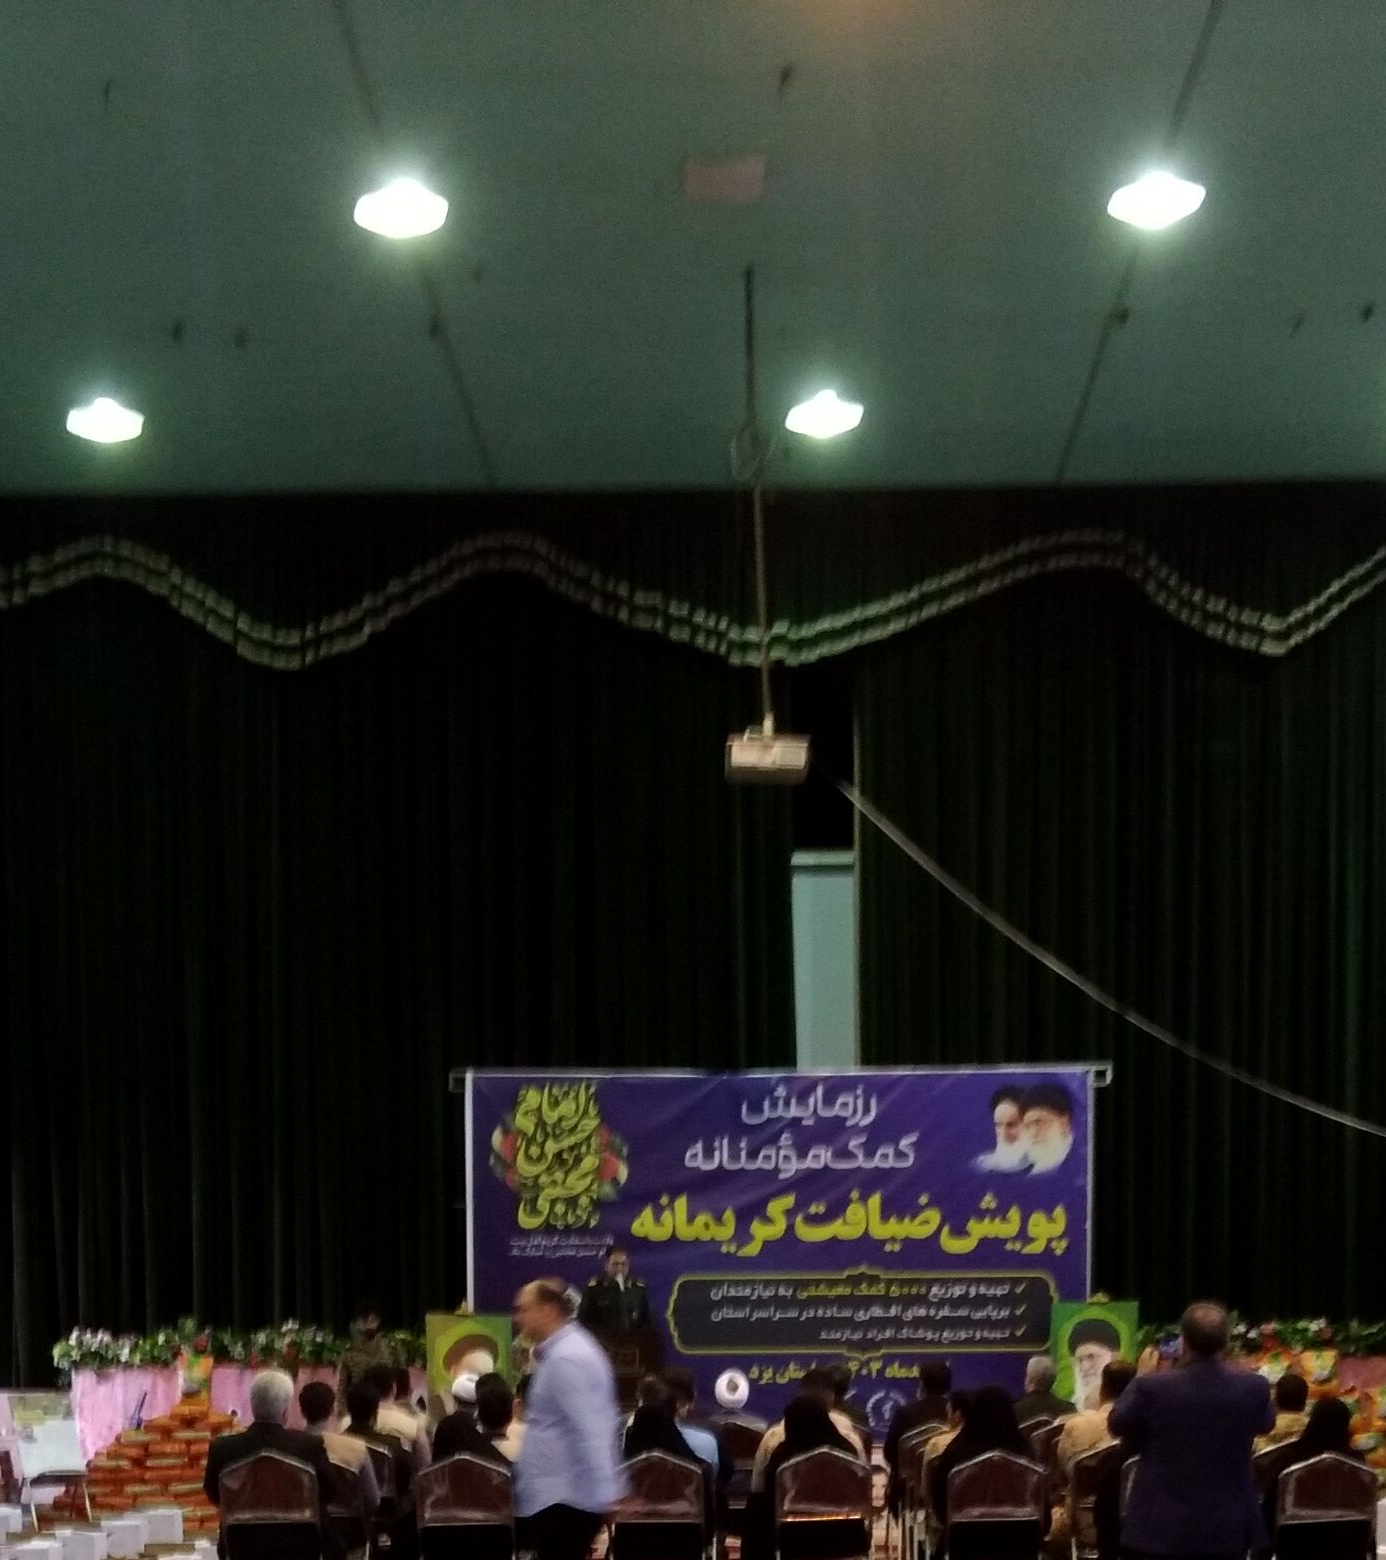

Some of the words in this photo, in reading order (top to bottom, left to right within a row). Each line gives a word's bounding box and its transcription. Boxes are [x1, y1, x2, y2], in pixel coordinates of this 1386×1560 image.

[741, 1083, 878, 1127] رزمایش
[684, 1131, 827, 1180] مؤمنانه
[826, 1131, 920, 1170] کمک
[631, 1192, 796, 1256] کریمانه
[795, 1189, 941, 1253] ضیافت
[939, 1192, 1068, 1255] پویش
[710, 1281, 775, 1300] نیازمندان
[929, 1282, 967, 1301] توزیع
[978, 1282, 1010, 1297] تهیه
